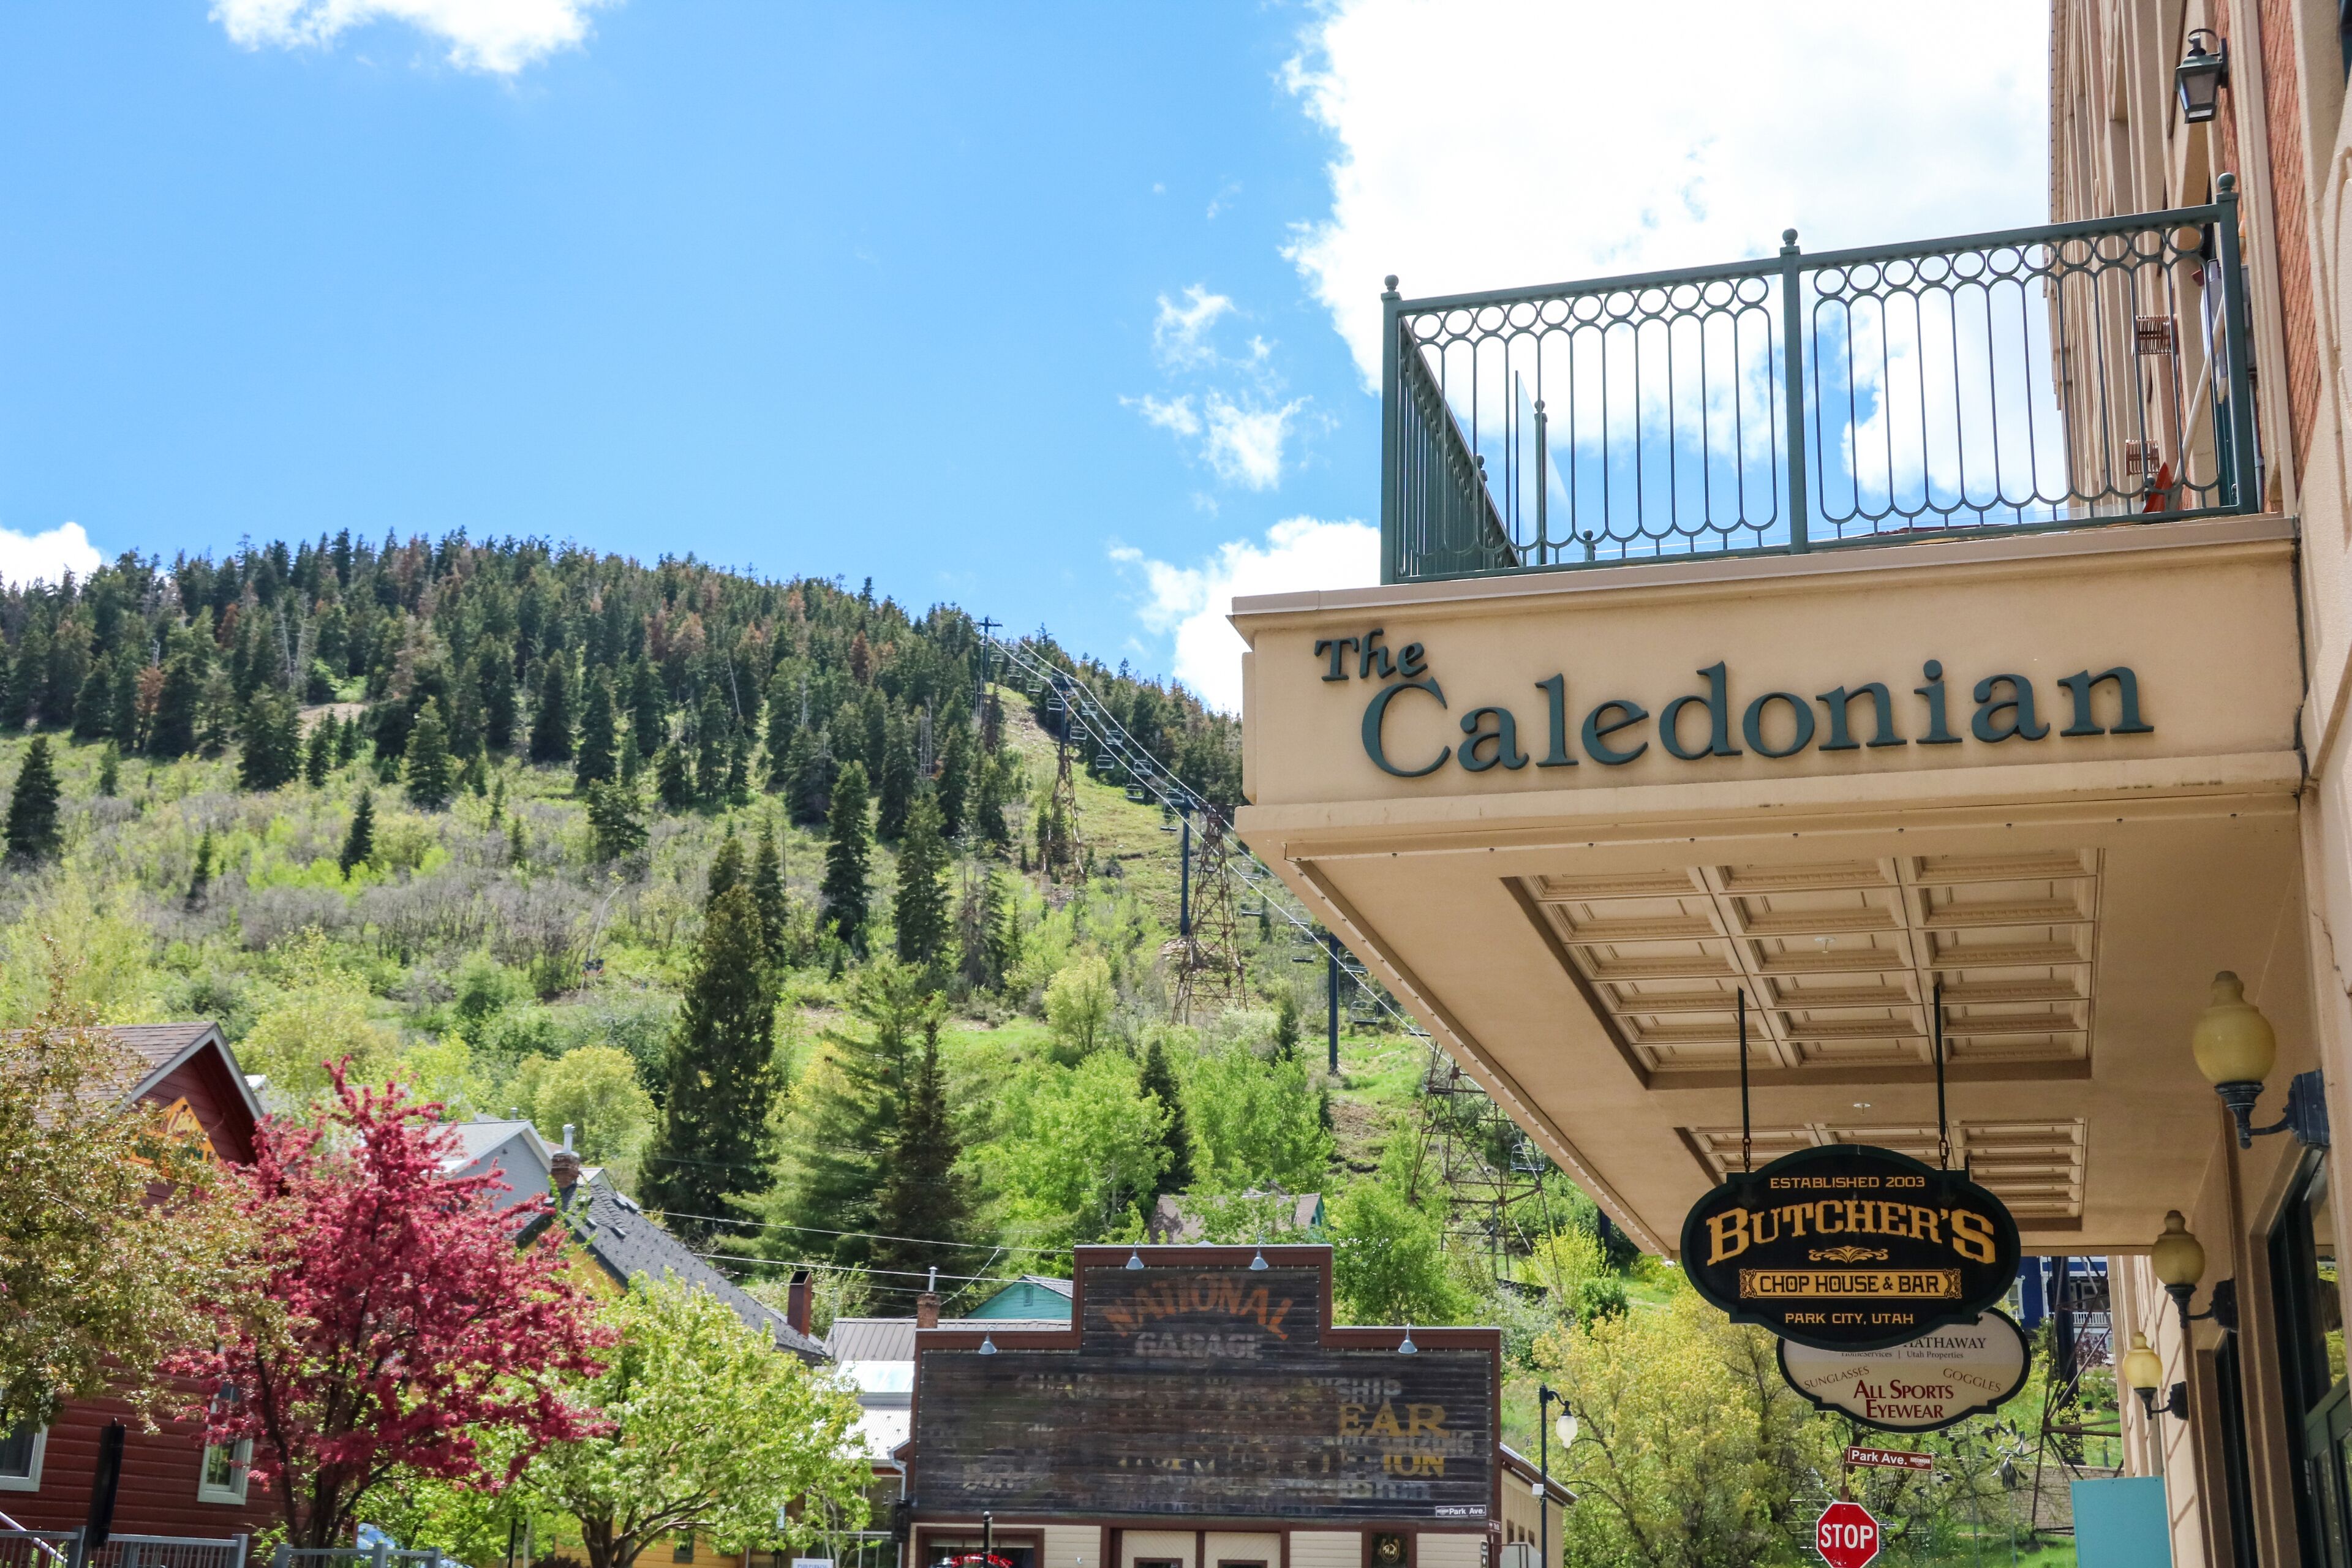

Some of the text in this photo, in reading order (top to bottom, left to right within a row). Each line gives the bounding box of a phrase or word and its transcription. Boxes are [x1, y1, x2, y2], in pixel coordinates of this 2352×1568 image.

[1314, 628, 1428, 681] The
[1361, 659, 2155, 778] Caledonian
[1770, 1175, 1925, 1189] ESTABLISHED 2003
[1706, 1200, 1996, 1265] BUTCHER'S
[1760, 1276, 1940, 1293] CHOP HOUSE & BAR
[1104, 1273, 1294, 1341] NATIONAL
[1785, 1313, 1914, 1325] PARK CITY, UTAH
[1134, 1331, 1263, 1360] GARAGE
[1804, 1366, 1870, 1389] SUNGLASSES
[1853, 1379, 1954, 1400] ALL SPORTS
[1943, 1368, 2002, 1393] GOGGLES
[1865, 1399, 1944, 1419] EYEWEAR
[1852, 1450, 1878, 1463] Park
[1881, 1453, 1907, 1465] Ave.
[1820, 1523, 1874, 1549] STOP
